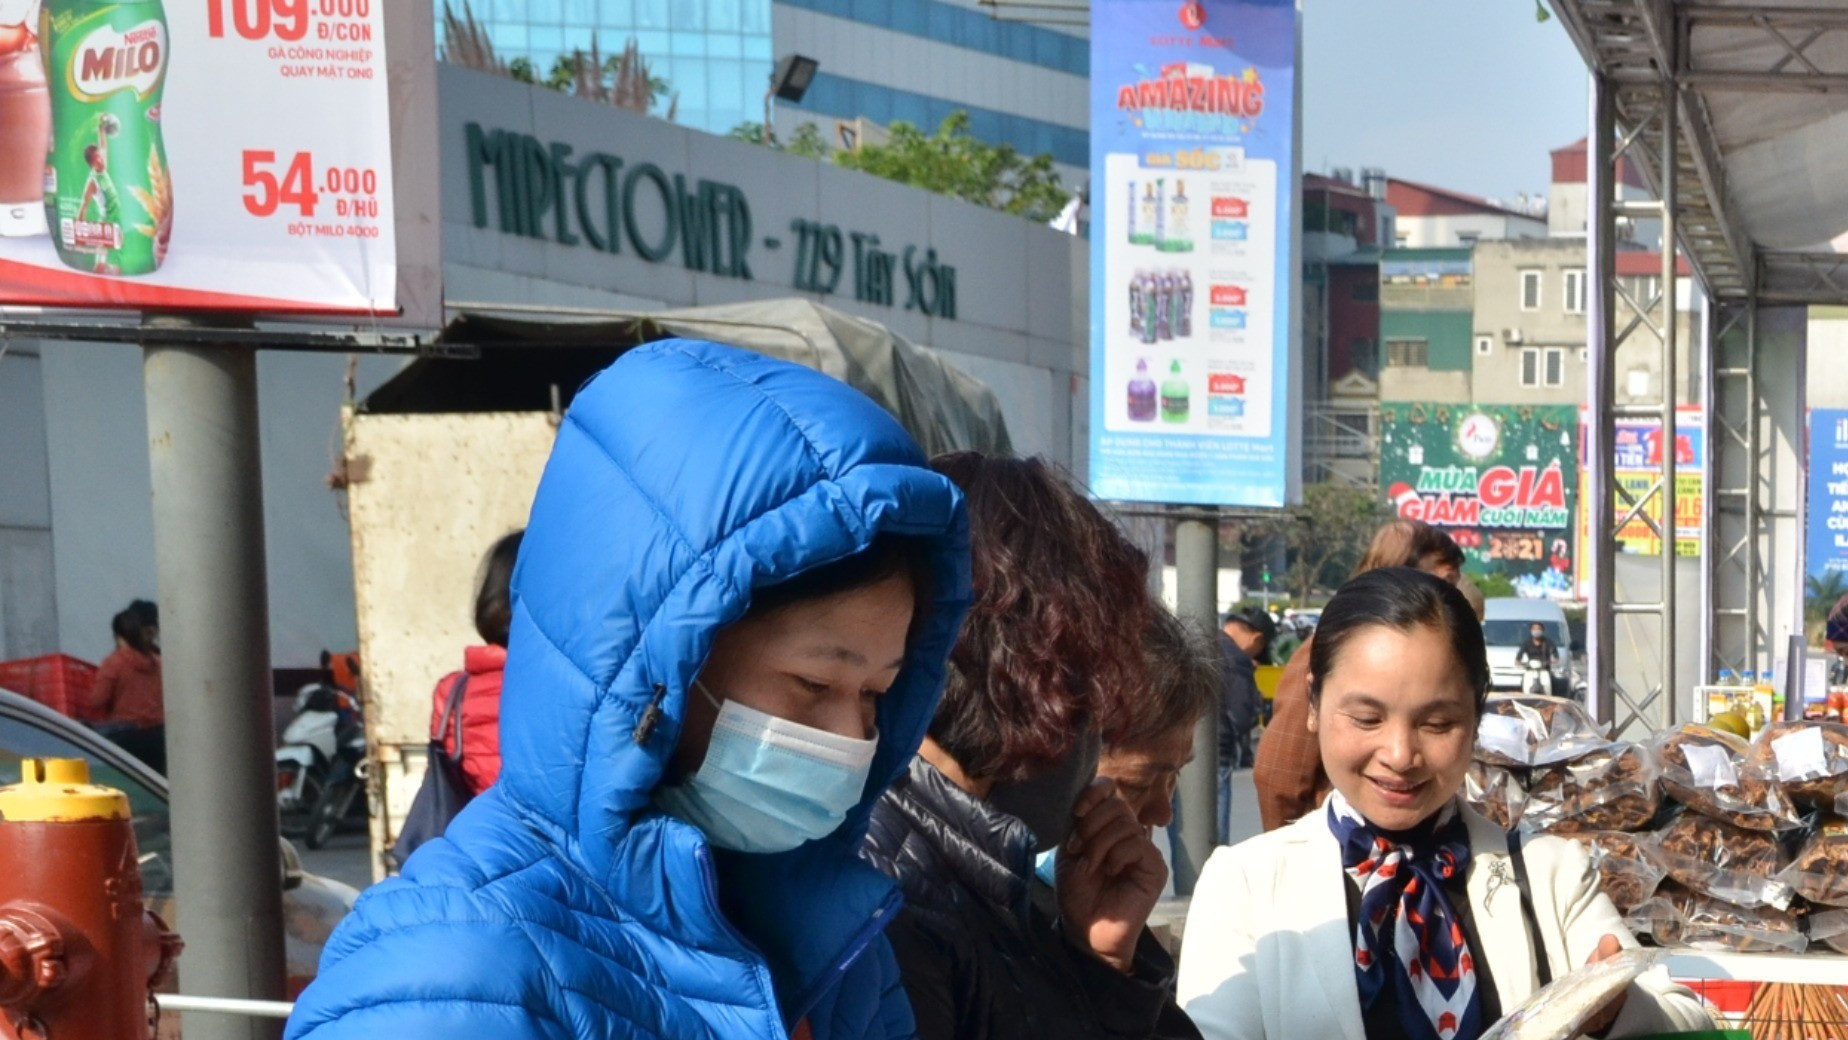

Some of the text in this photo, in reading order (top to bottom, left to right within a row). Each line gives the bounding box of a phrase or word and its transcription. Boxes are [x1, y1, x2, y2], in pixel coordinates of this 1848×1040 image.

[317, 22, 371, 42] Đ/CON
[81, 41, 160, 82] MILO
[288, 46, 324, 60] CÔNG
[326, 49, 373, 62] NGHIỆP
[280, 65, 374, 80] QUAY MẬT ONG
[1117, 75, 1265, 119] AMAZING
[315, 224, 344, 236] MILO
[1478, 458, 1566, 508] GIÁ
